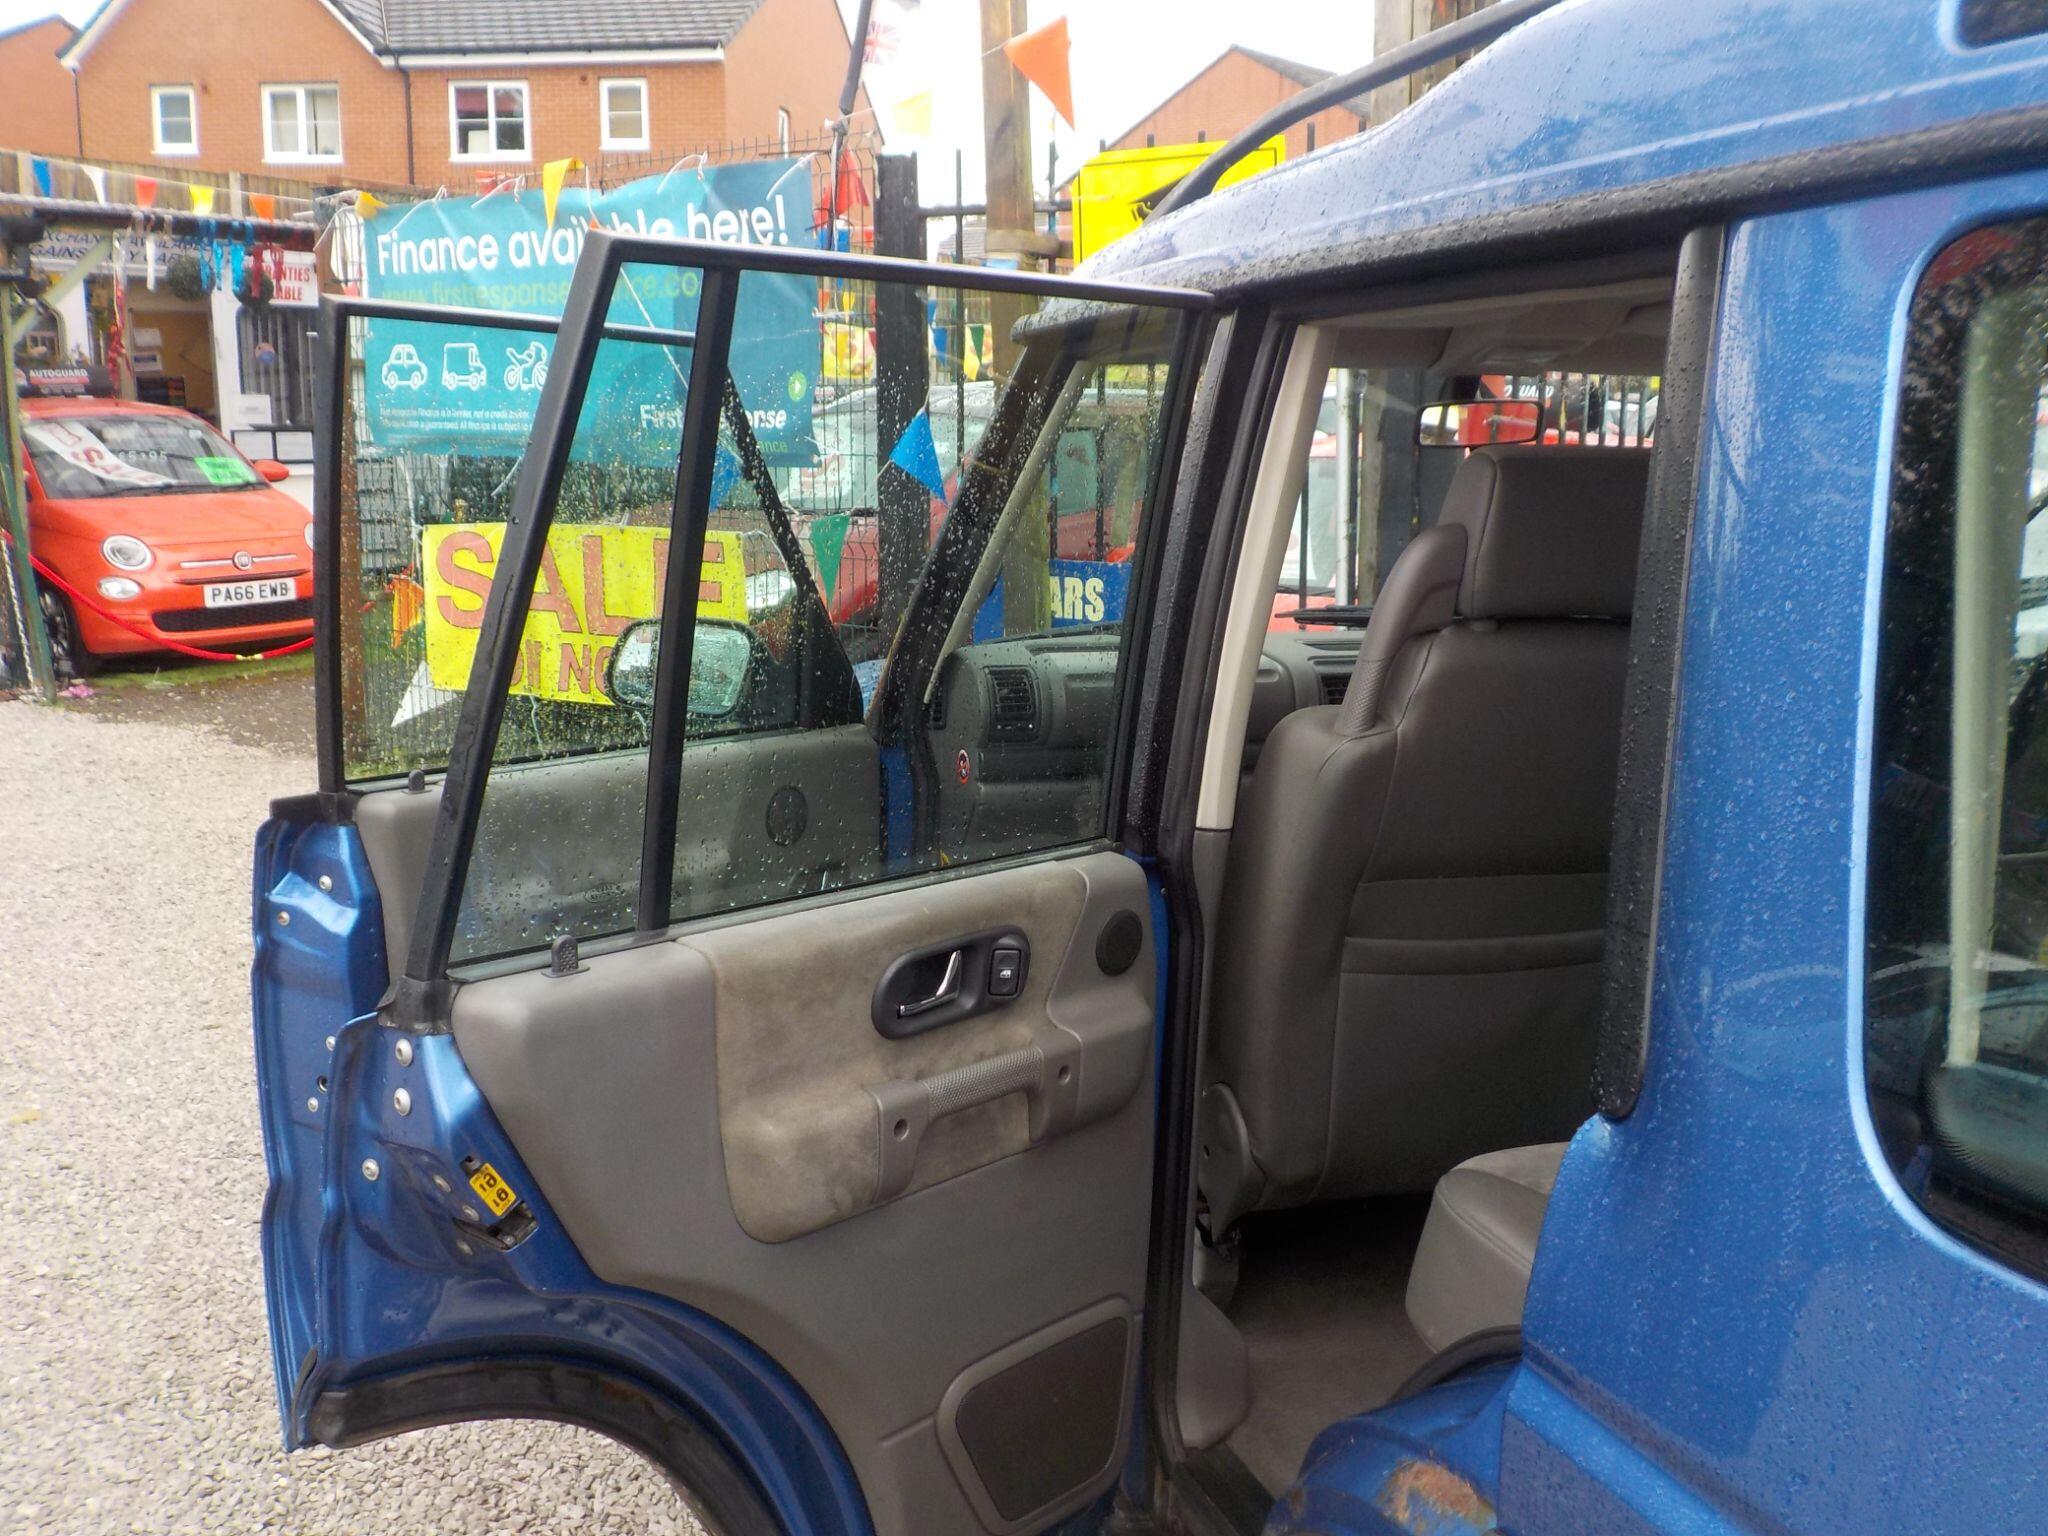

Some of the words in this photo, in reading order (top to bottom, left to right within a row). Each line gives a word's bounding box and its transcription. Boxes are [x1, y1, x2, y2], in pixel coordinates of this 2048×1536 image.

[377, 231, 499, 275] Finance
[687, 194, 789, 245] here!
[29, 368, 88, 377] AUTOGUARD
[211, 585, 254, 602] PA66
[259, 582, 288, 599] EWB
[1050, 576, 1104, 621] ARS
